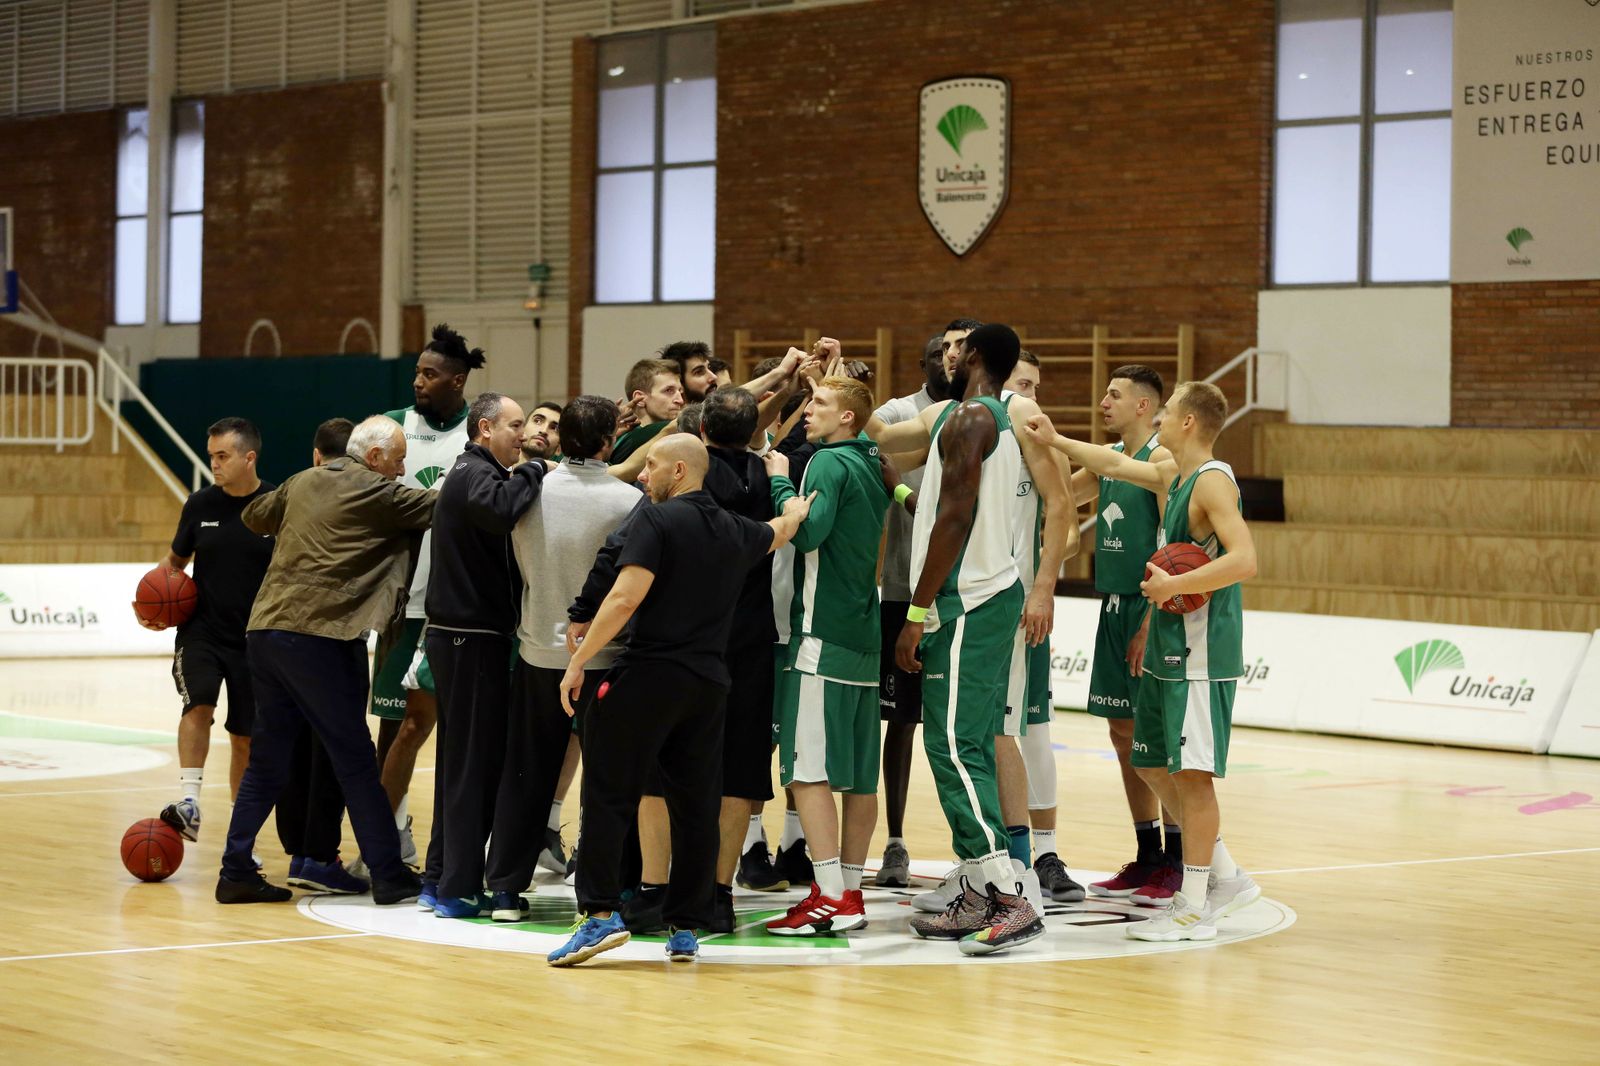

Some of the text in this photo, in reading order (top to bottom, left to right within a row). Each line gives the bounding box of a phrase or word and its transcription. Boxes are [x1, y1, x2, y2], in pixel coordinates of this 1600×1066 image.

[1516, 49, 1593, 66] NUESTROS
[1464, 78, 1585, 105] ESFUERZO
[1478, 111, 1584, 136] ENTREGA
[1546, 144, 1600, 165] EQUI
[936, 164, 986, 186] Unicaja
[11, 606, 99, 629] Unicaja
[1050, 647, 1088, 677] caja
[373, 695, 408, 709] worte
[1089, 694, 1130, 708] worten
[1450, 675, 1535, 708] Unicaja
